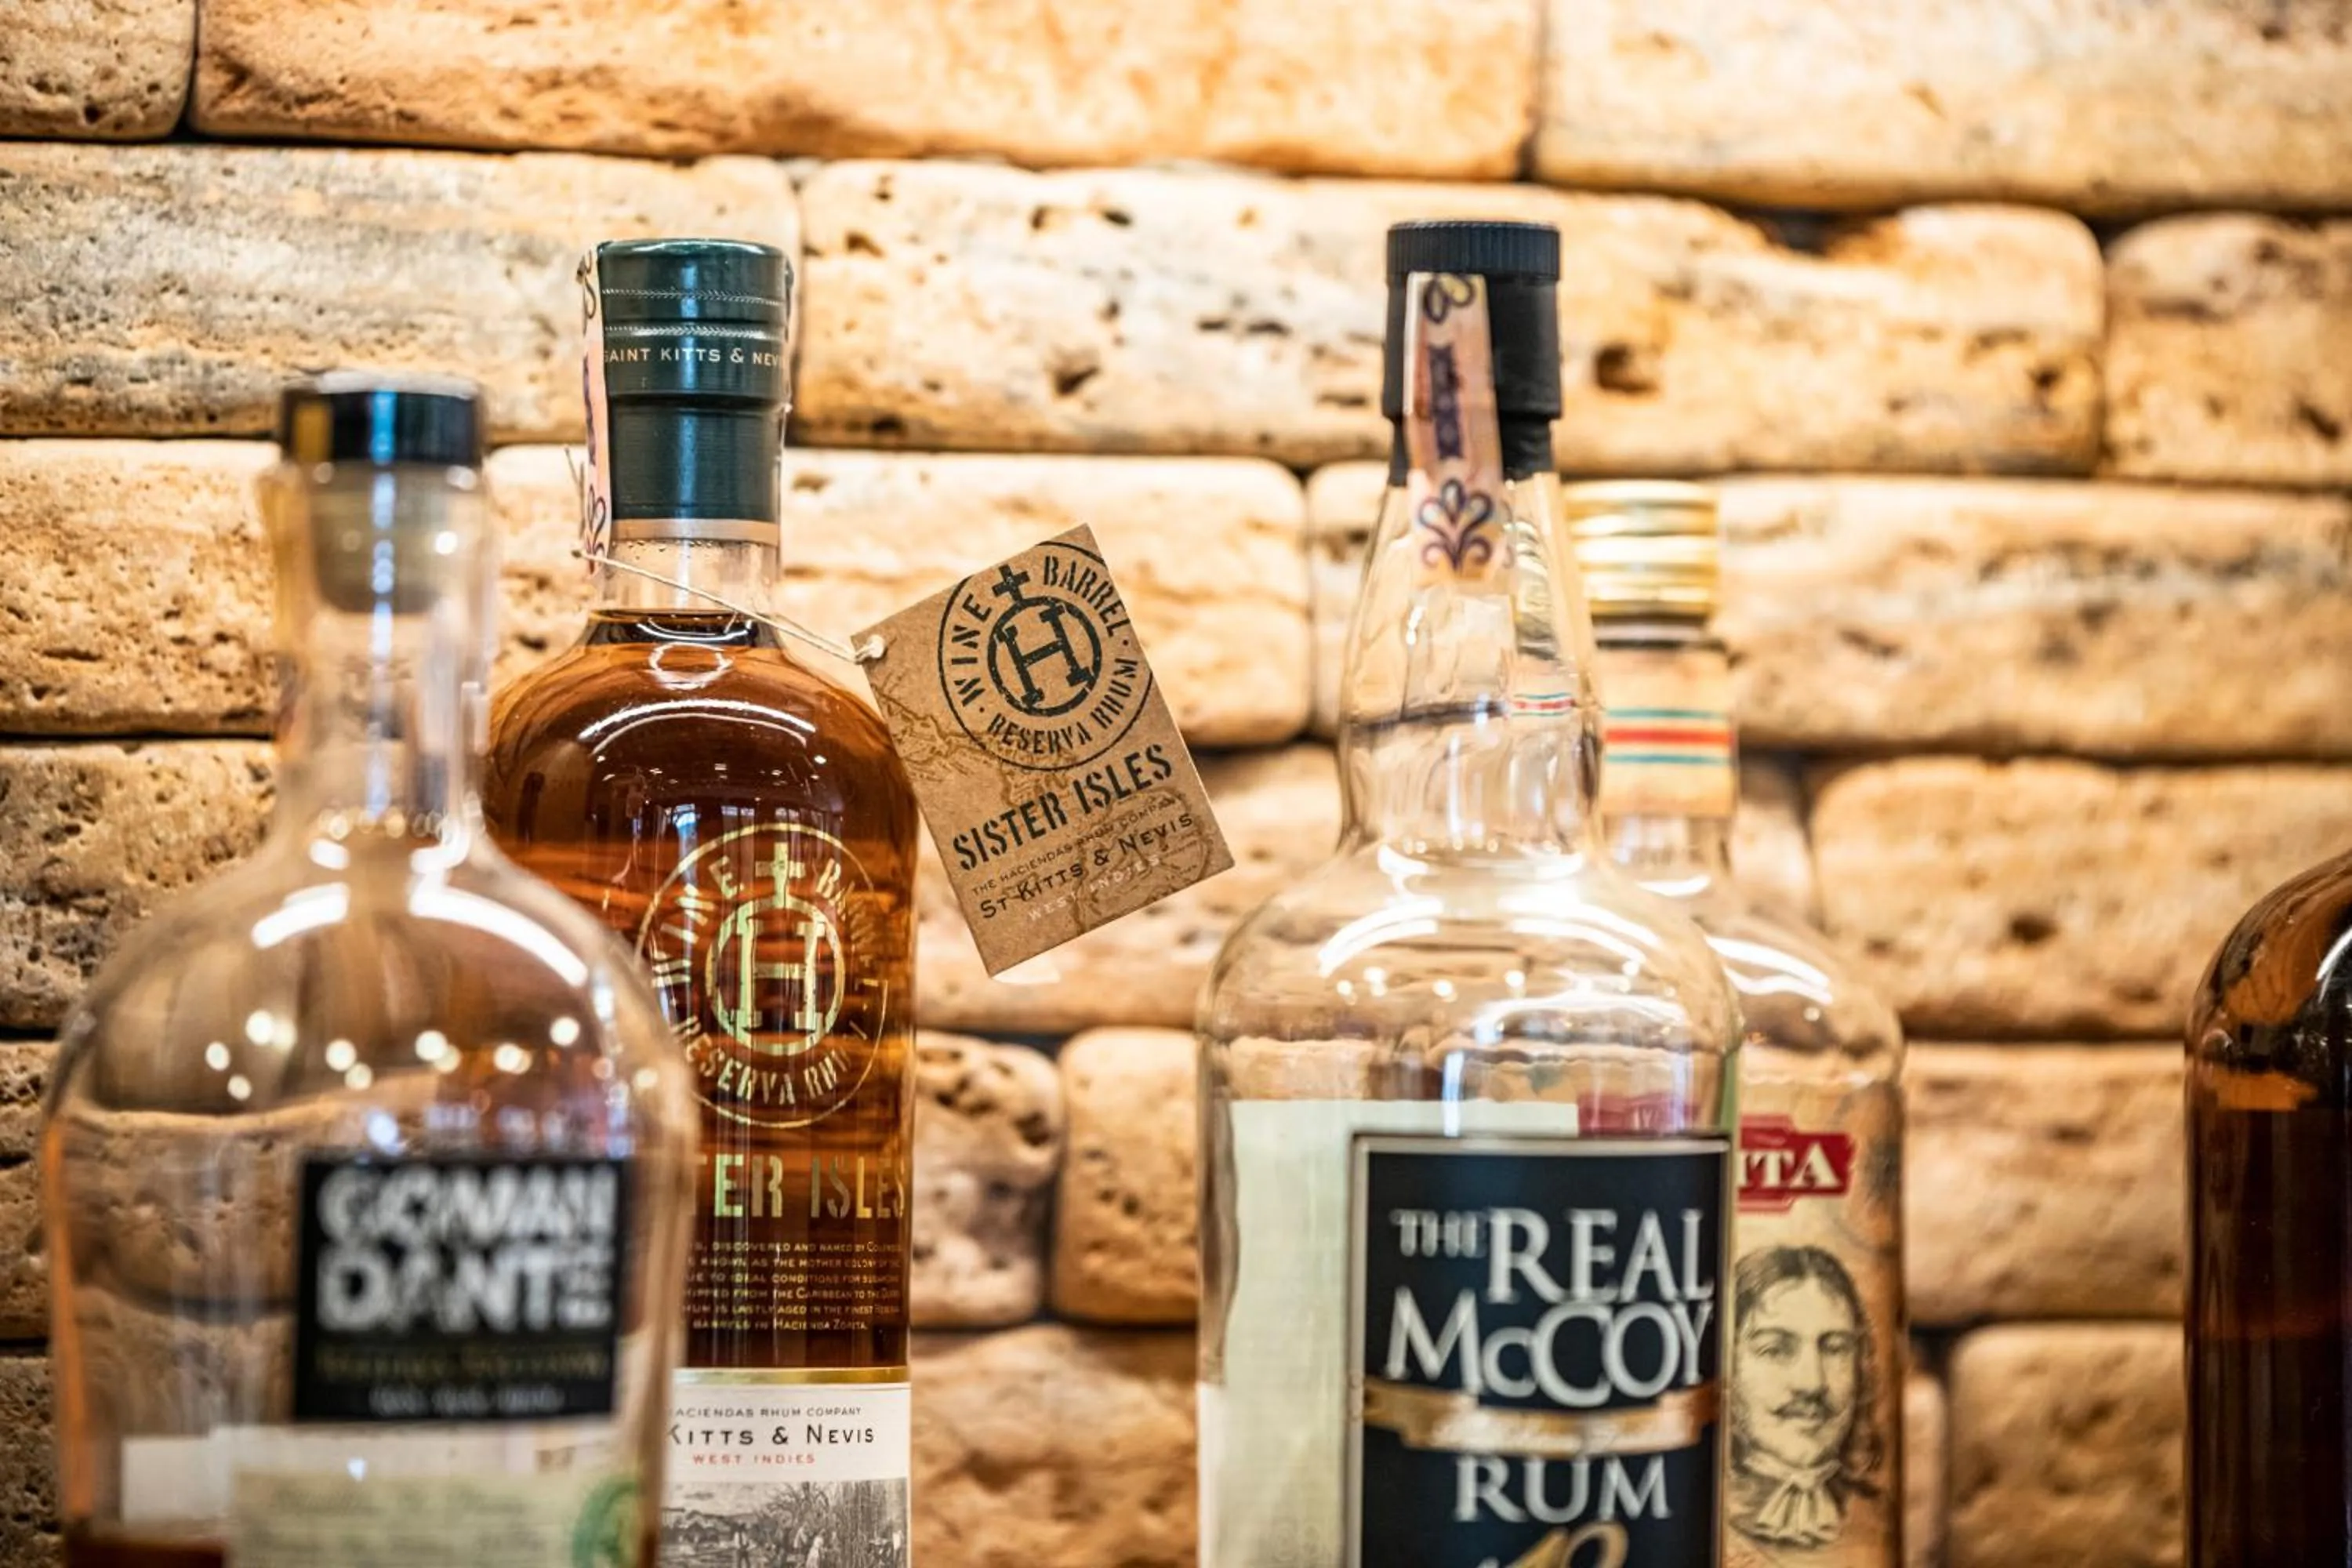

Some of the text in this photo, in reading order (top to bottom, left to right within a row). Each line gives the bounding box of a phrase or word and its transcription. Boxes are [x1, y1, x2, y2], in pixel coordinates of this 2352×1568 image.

[661, 347, 720, 362] KITTS
[731, 347, 745, 363] &
[753, 352, 781, 366] NEV
[950, 555, 1131, 706] WINE BARREL
[986, 658, 1138, 755] RESERVA RHUM
[952, 743, 1173, 871] SISTER ISLES
[971, 879, 997, 896] THE
[1000, 844, 1074, 883] HACIENDAS
[1093, 849, 1111, 867] &
[698, 1153, 905, 1218] ER ISLES
[773, 1257, 795, 1269] THE
[1390, 1207, 1715, 1304] THE REAL
[670, 1406, 862, 1418] ACIENDAS RHUM COMPANY
[771, 1425, 789, 1446] &
[693, 1453, 816, 1465] WEST INDIES
[1454, 1454, 1673, 1524] RUM
